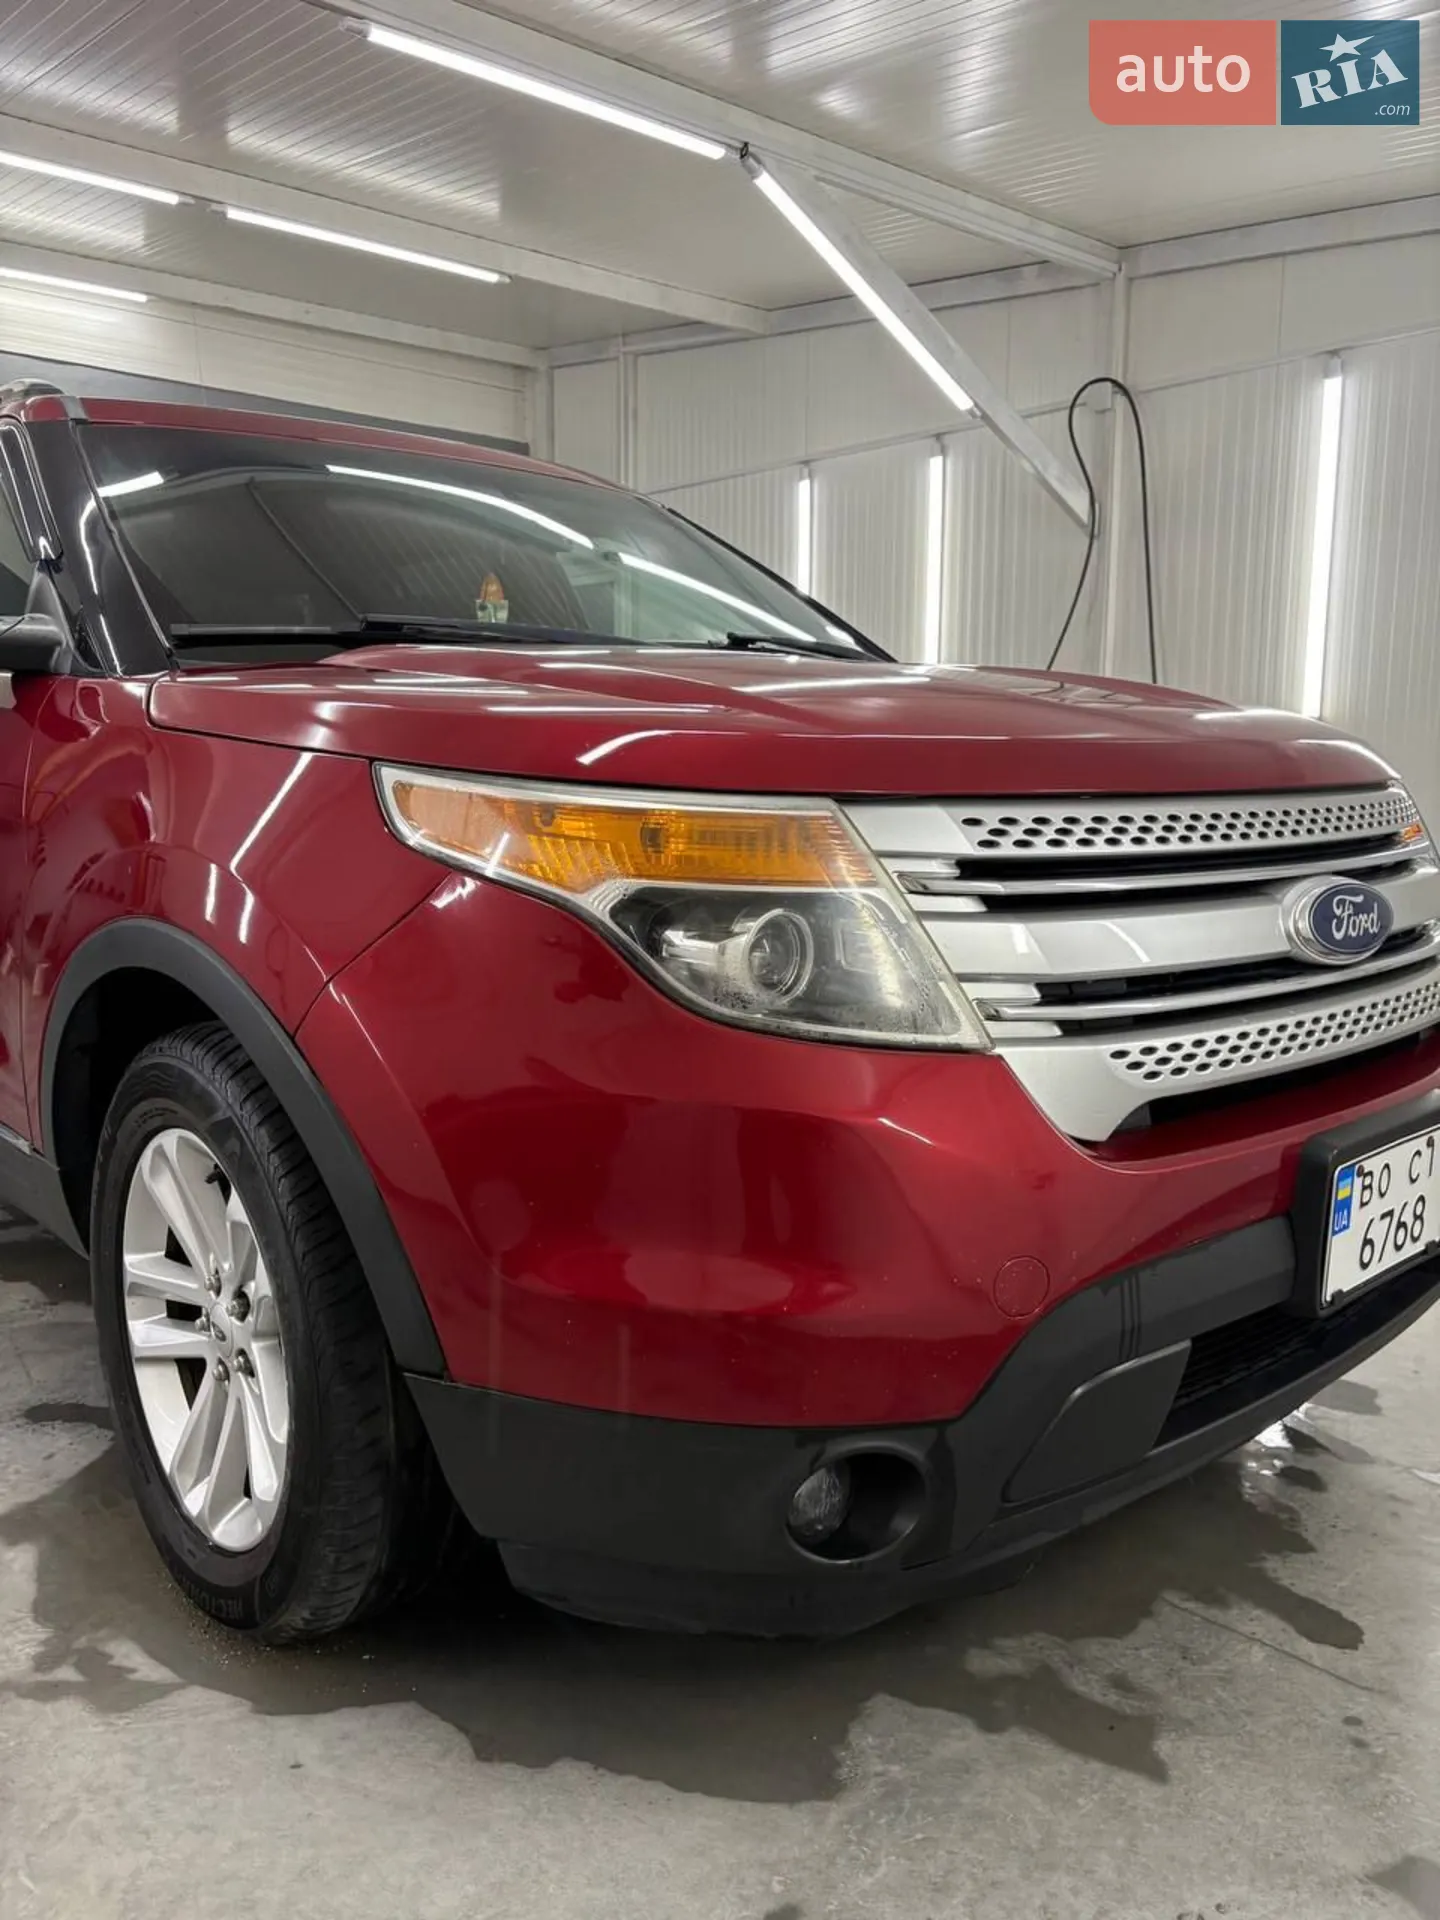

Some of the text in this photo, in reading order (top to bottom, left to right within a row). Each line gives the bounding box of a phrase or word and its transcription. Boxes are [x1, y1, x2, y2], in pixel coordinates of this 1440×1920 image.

[1331, 894, 1381, 941] Ford
[1359, 1162, 1391, 1209] BO
[1334, 1207, 1349, 1231] UA
[1359, 1193, 1426, 1271] 6768
